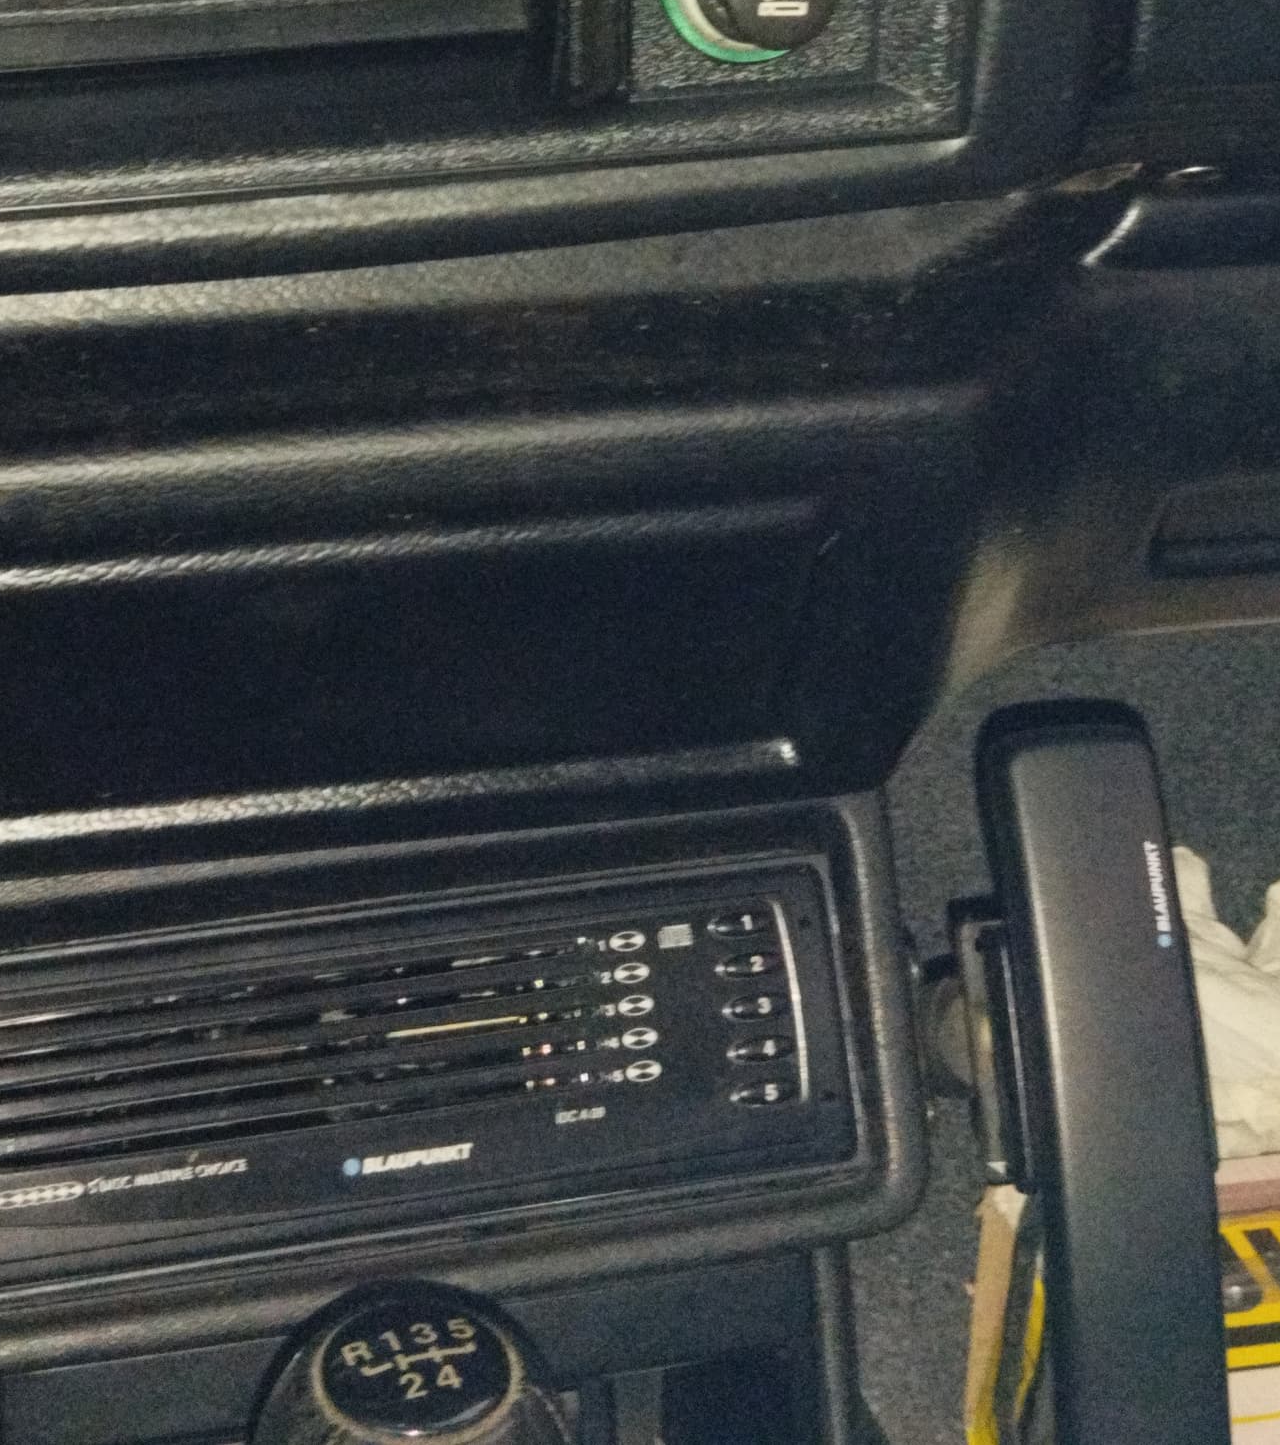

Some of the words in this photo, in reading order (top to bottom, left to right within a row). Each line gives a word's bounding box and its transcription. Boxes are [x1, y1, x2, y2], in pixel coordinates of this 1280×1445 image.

[1144, 840, 1171, 932] BLAUPUNKT
[740, 914, 754, 931] 1
[750, 955, 765, 973] 2
[757, 997, 772, 1015] 3
[762, 1039, 777, 1056] 4
[764, 1083, 779, 1101] 5
[362, 1142, 474, 1174] BLAUPUNKT
[340, 1340, 374, 1367] R
[379, 1329, 402, 1351] 1
[409, 1322, 438, 1344] 3
[447, 1317, 477, 1340] 5
[399, 1372, 429, 1400] 2
[436, 1364, 463, 1389] 4
